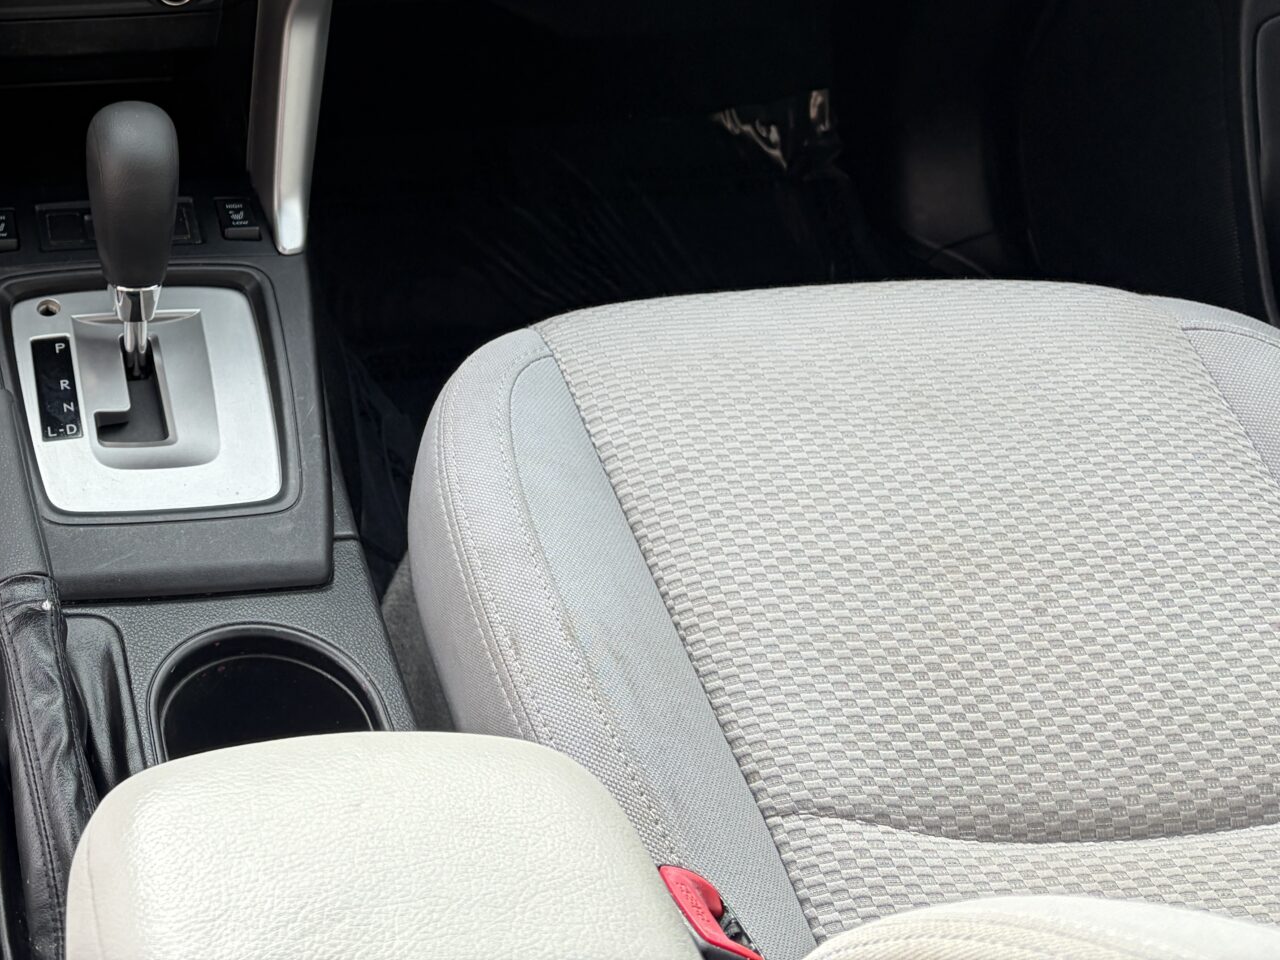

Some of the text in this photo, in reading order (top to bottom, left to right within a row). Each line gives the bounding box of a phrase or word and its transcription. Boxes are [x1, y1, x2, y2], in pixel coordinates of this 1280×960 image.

[54, 342, 66, 354] P
[59, 379, 71, 391] R
[62, 401, 75, 413] N
